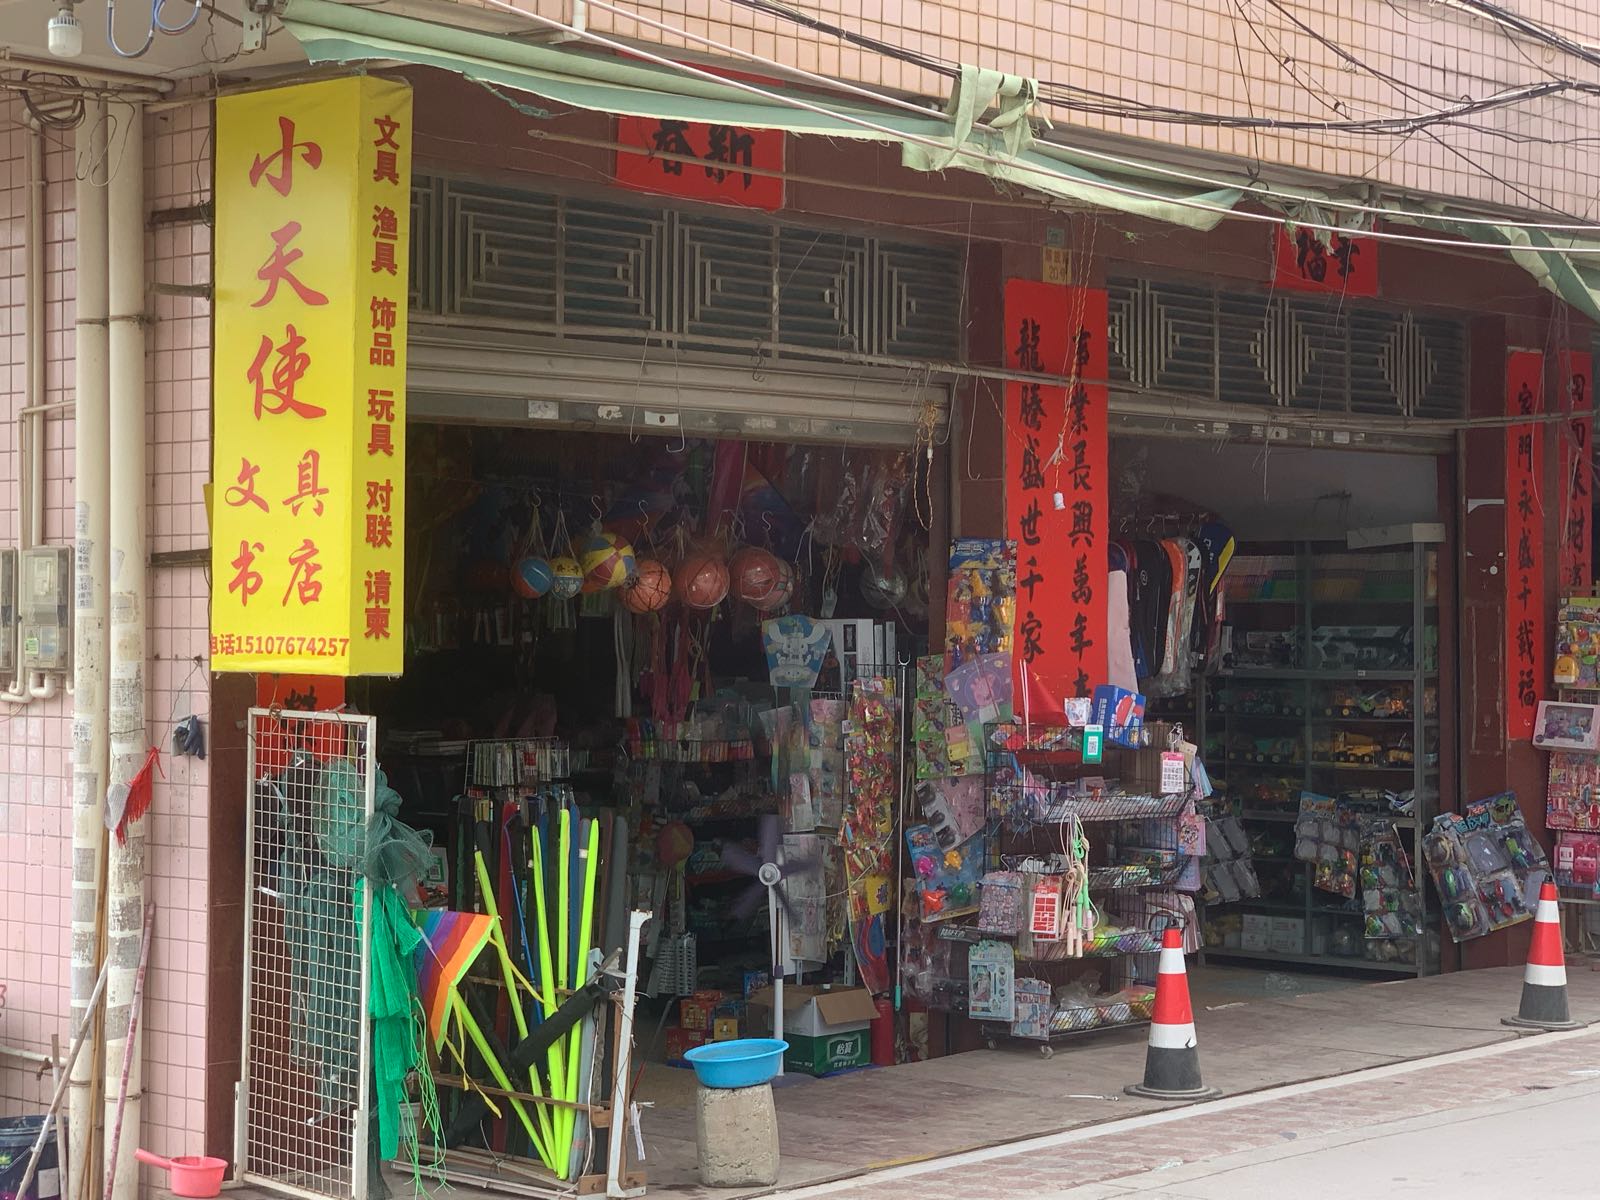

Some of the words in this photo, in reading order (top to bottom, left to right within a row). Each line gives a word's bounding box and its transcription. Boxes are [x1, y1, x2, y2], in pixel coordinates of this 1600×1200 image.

[373, 115, 400, 186] 文具
[247, 116, 329, 420] 小天使
[371, 205, 399, 277] 渔具
[369, 296, 398, 367] 饰品
[367, 389, 395, 456] 玩具
[225, 449, 329, 517] 文具
[365, 479, 393, 549] 对联
[228, 539, 322, 607] 书店
[364, 570, 391, 640] 请柬
